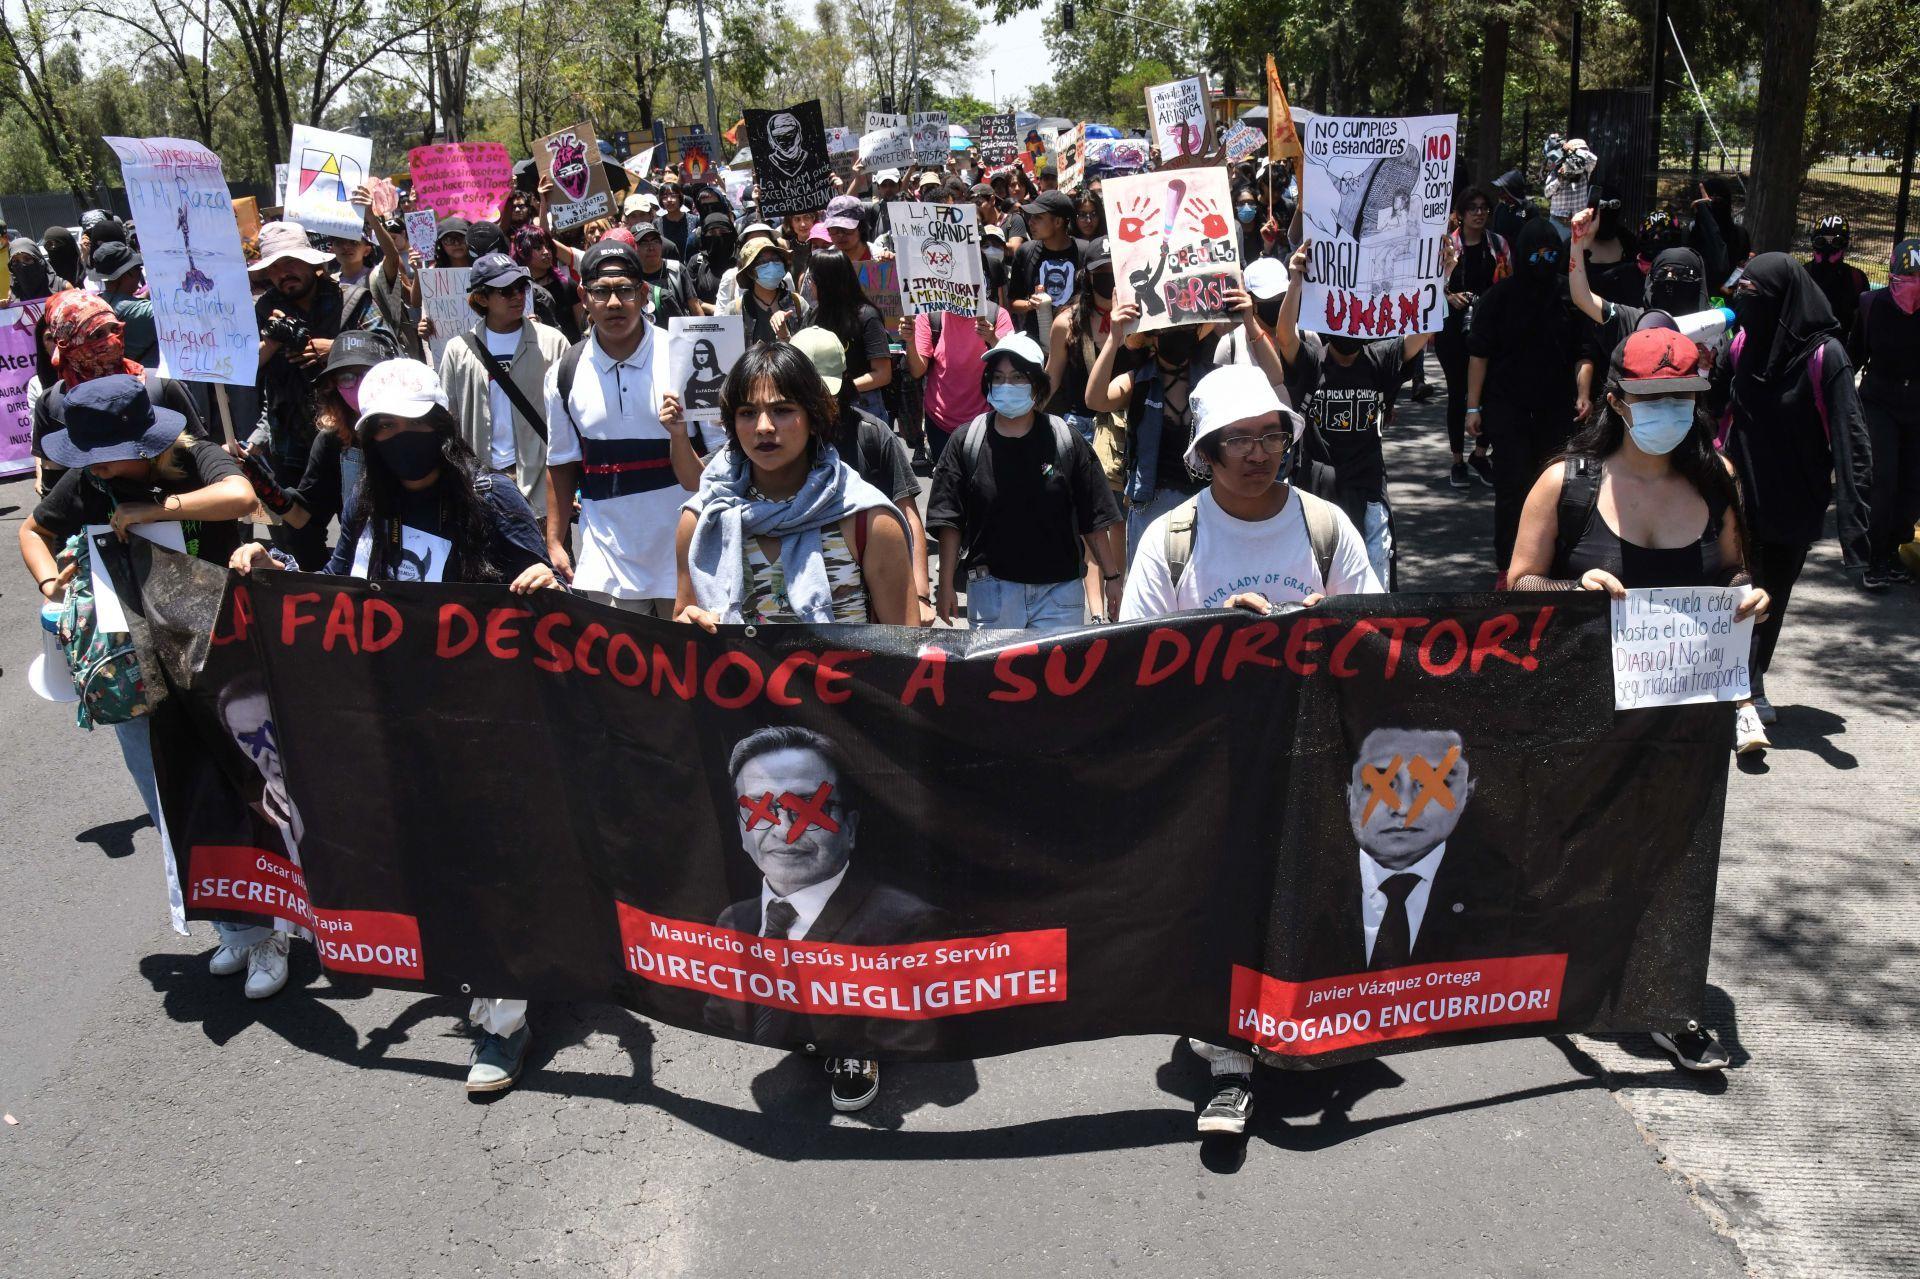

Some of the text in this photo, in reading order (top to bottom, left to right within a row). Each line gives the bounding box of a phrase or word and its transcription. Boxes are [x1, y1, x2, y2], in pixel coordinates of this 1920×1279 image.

[1315, 122, 1338, 139] NO
[908, 203, 964, 224] LA FAD
[1819, 215, 1843, 229] NP
[928, 220, 976, 245] GRANDE
[1326, 388, 1344, 400] PICK
[1345, 388, 1355, 400] UP
[1228, 575, 1260, 592] LADY
[1264, 573, 1281, 584] OF
[1649, 589, 1702, 615] Escuela
[1707, 589, 1734, 614] está
[1615, 613, 1732, 643] hasta el culo del
[281, 592, 404, 656] FAD
[436, 602, 874, 710] DESCONOCE
[901, 645, 949, 707] A
[988, 637, 1109, 703] SU
[1136, 605, 1557, 687] DIRECTOR!
[1679, 642, 1700, 666] No
[1704, 639, 1725, 670] hay
[256, 855, 290, 880] Óscar
[650, 921, 1012, 972] Mauricio de Jesús Juárez Servín
[628, 944, 1058, 1013] ¡DIRECTOR NEGLIGENTE!
[1306, 969, 1482, 1009] Javier Vázquez Ortega
[1237, 988, 1551, 1043] ¡ABOGADO ENCUBRIDOR!
